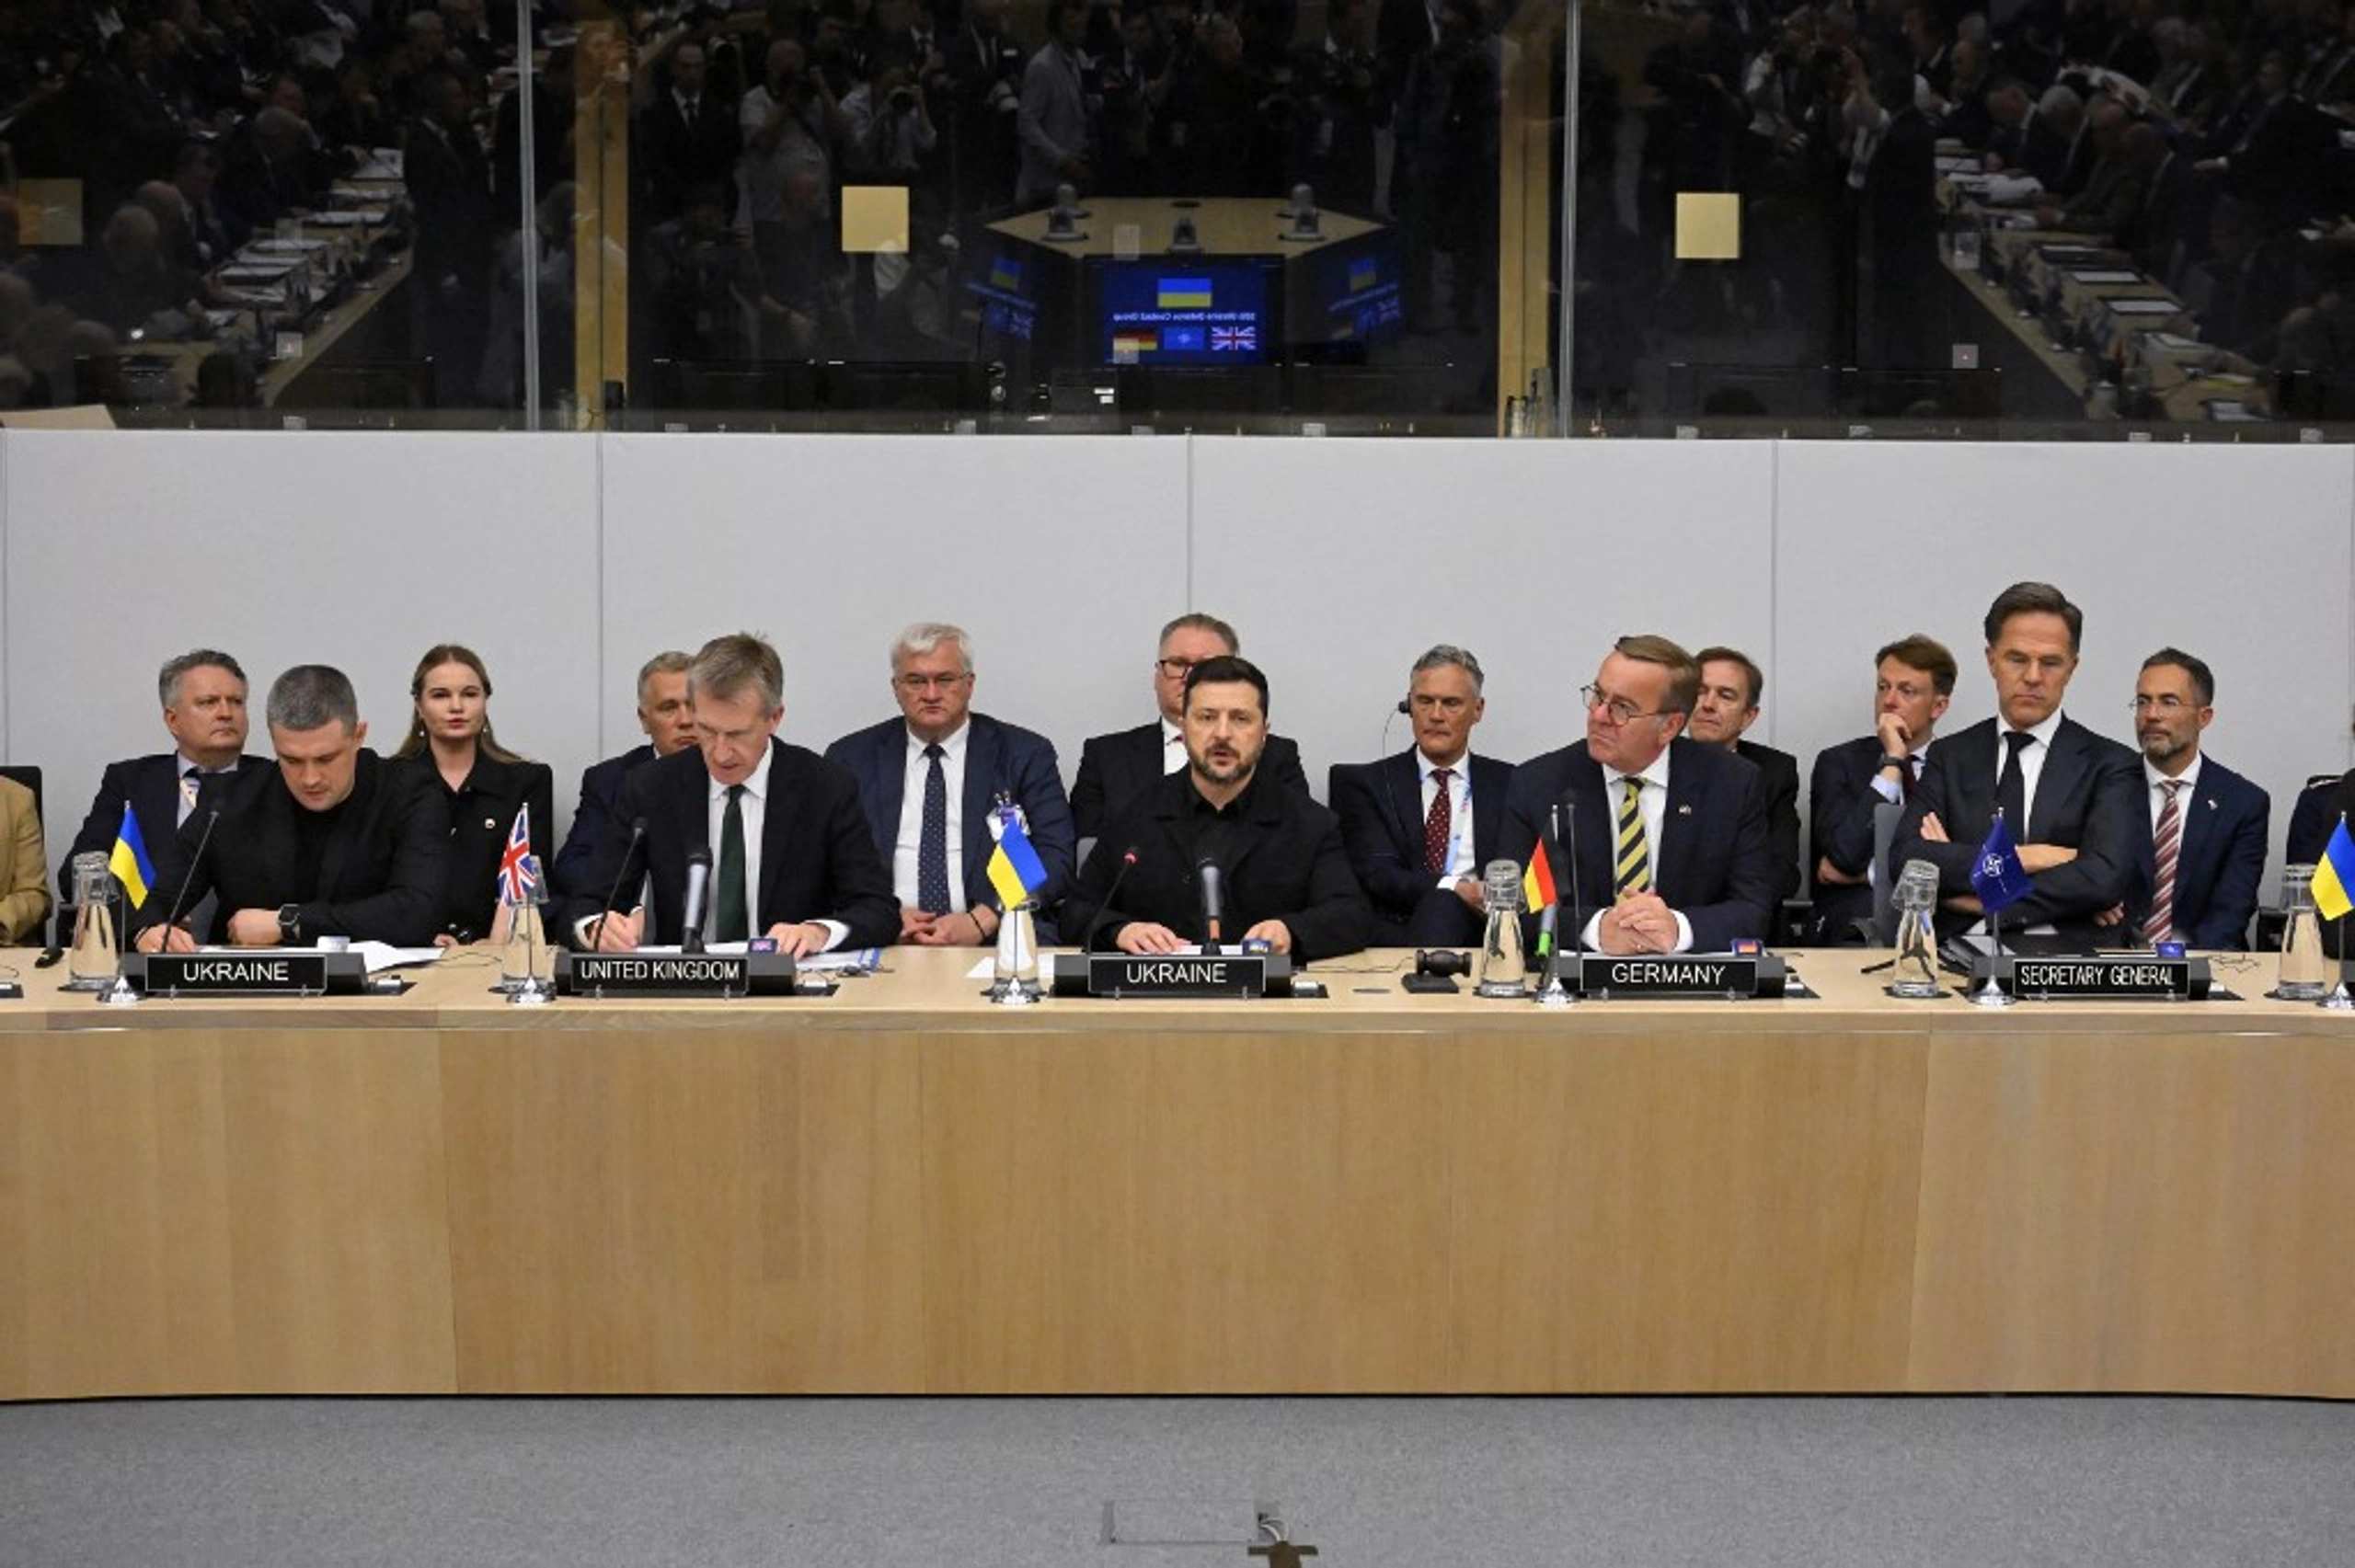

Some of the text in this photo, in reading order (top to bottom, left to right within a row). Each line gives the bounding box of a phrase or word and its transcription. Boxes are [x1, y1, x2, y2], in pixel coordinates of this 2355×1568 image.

[183, 962, 289, 981] UKRAINE
[580, 960, 740, 980] UNITED KINGDOM
[1126, 963, 1227, 983] UKRAINE
[1612, 963, 1726, 984] GERMANY
[2021, 965, 2175, 985] SECRETARY GENERAL
